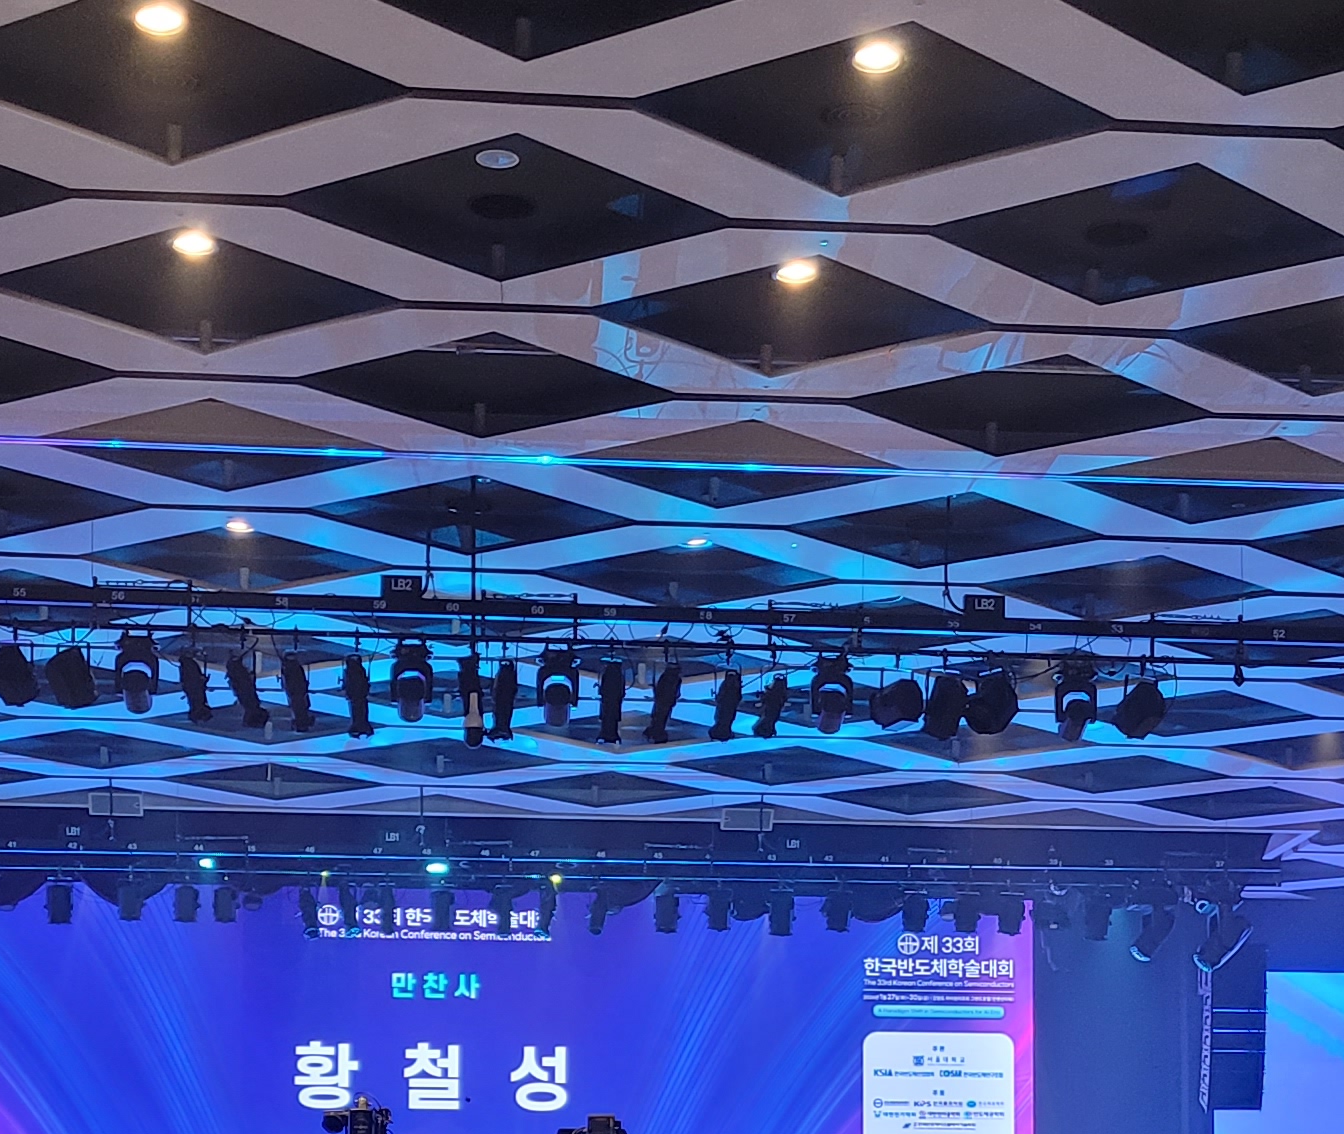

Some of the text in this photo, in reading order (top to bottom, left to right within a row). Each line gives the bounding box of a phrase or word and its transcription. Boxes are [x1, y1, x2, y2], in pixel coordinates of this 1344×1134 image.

[391, 578, 413, 591] LB2
[13, 588, 26, 597] 55
[111, 592, 125, 601] 56
[373, 600, 386, 609] 59
[446, 603, 460, 612] 60
[974, 598, 995, 611] LB2
[531, 606, 544, 615] 60
[603, 608, 616, 617] 59
[783, 614, 796, 623] 57
[65, 826, 81, 836] LB1
[385, 832, 400, 842] LB1
[786, 840, 801, 849] LB1
[400, 930, 457, 940] Conference
[458, 931, 471, 940] on
[921, 935, 980, 955] 제 33회
[862, 957, 1015, 979] 한국반도체학술대회
[863, 978, 877, 986] The
[892, 979, 916, 987] Korean
[917, 980, 954, 988] Conference
[964, 981, 1015, 989] Semiconductors
[292, 1041, 569, 1112] 황 철 성
